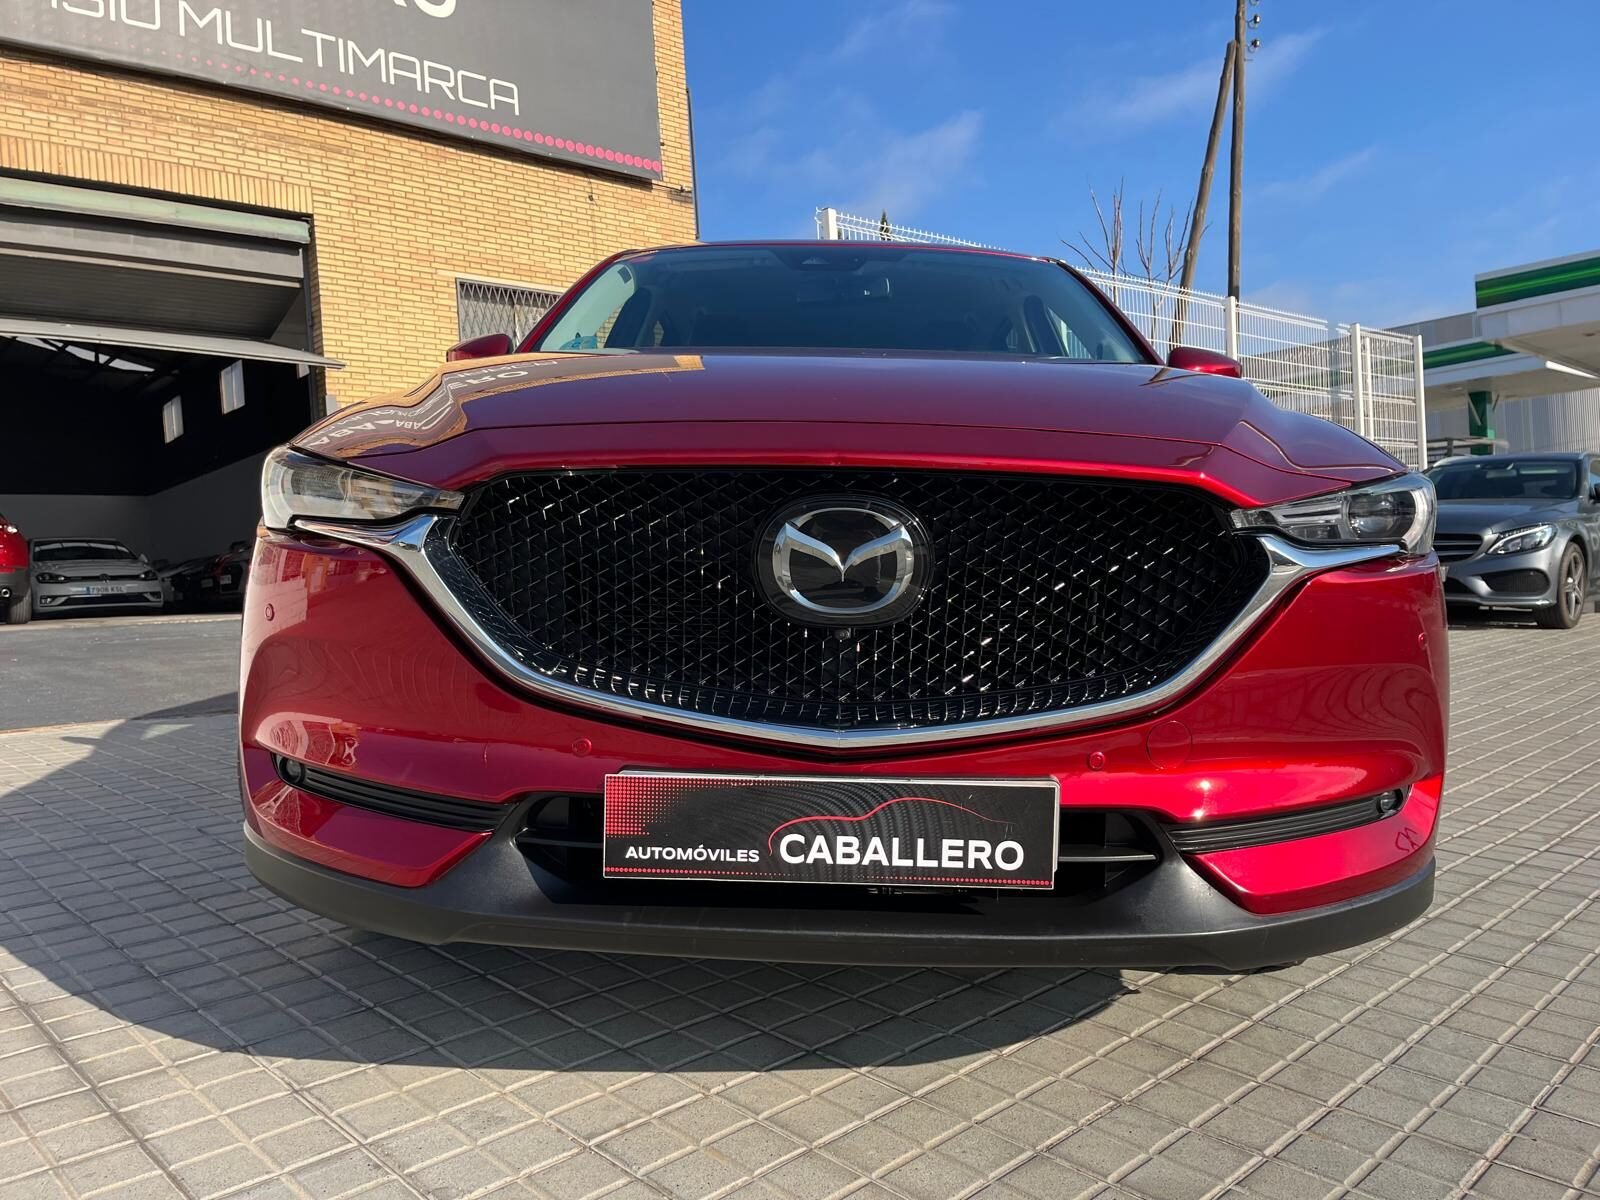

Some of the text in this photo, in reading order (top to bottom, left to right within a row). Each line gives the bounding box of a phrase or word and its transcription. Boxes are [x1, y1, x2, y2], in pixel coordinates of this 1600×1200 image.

[178, 0, 520, 116] MULTIMARCA
[624, 833, 1025, 871] AUTOMÓVILES CABALLERO
